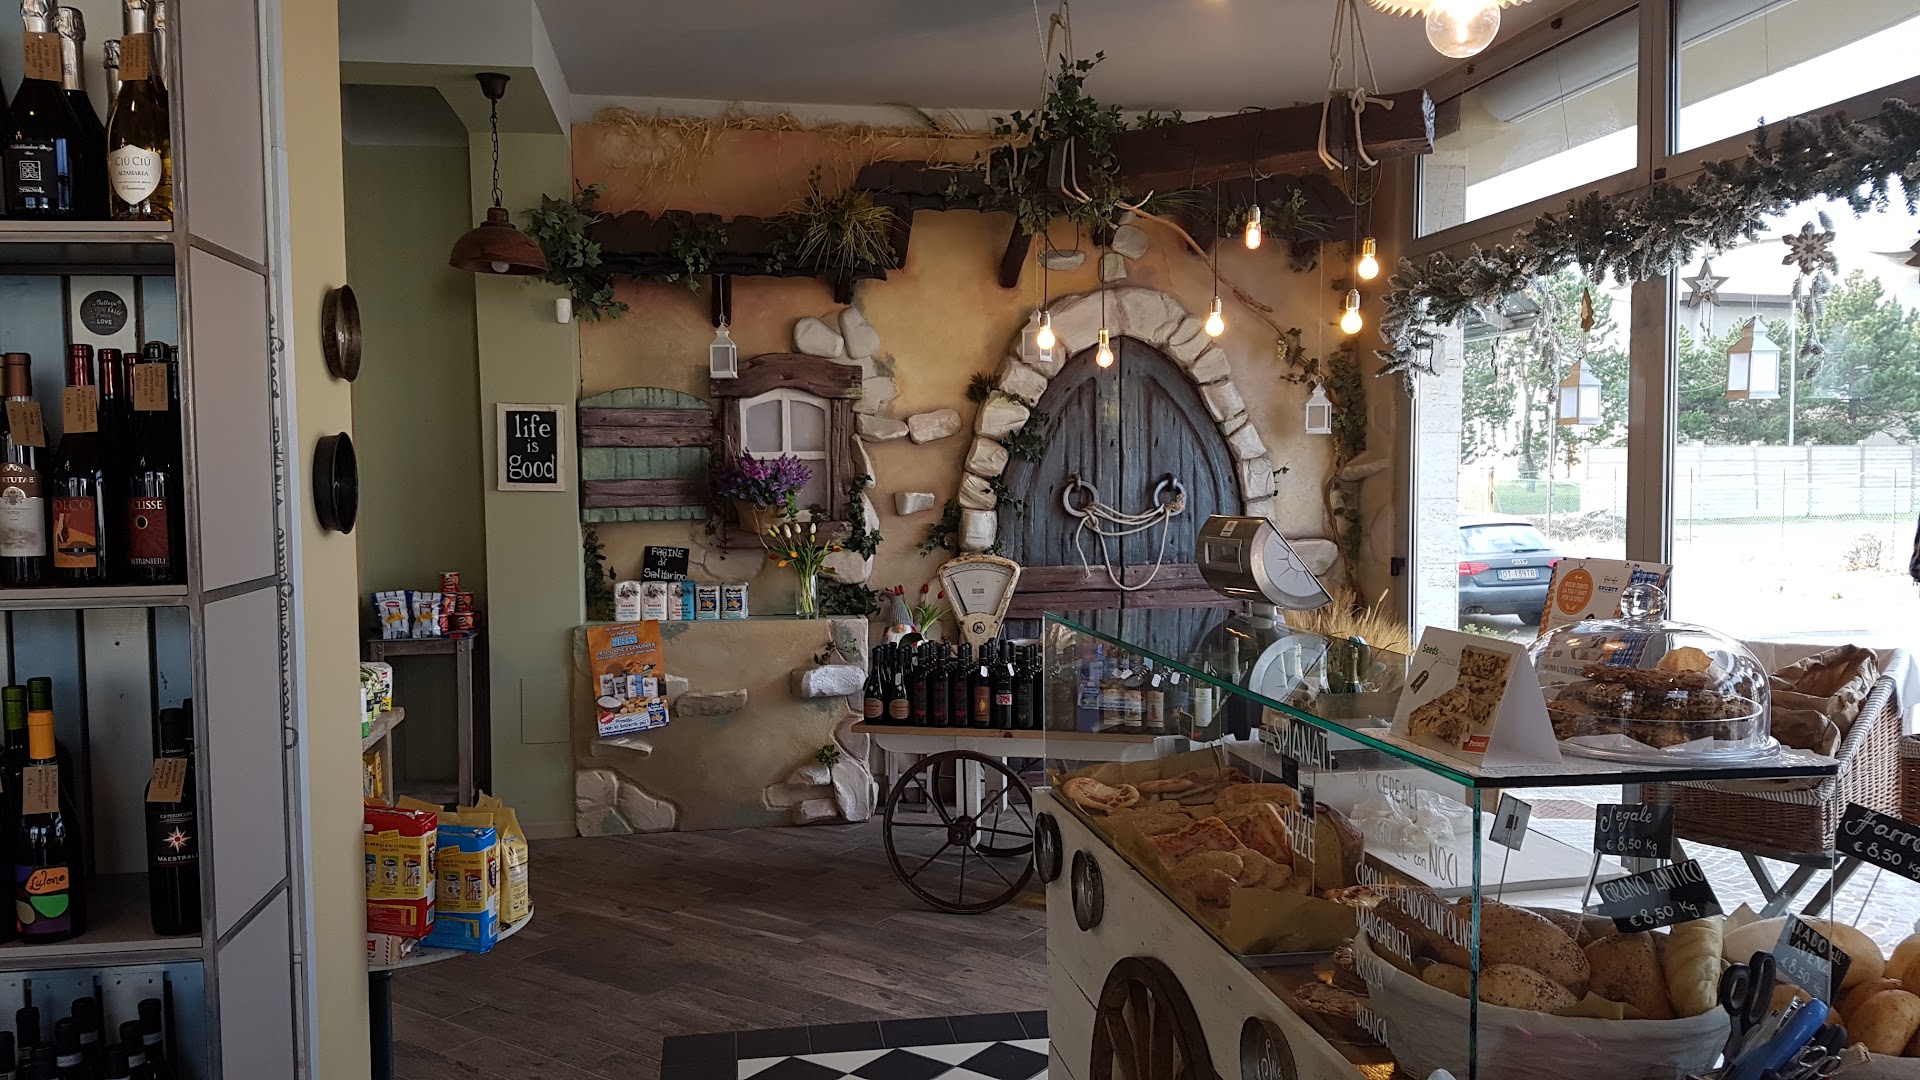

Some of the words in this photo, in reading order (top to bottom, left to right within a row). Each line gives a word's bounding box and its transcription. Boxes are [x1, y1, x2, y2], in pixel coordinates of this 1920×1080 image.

[116, 156, 130, 166] CIÙ
[132, 156, 151, 166] CIÙ
[515, 414, 551, 438] life
[526, 439, 540, 453] is
[509, 454, 556, 479] good
[52, 500, 92, 511] OLCO
[652, 547, 684, 558] FARINE
[658, 556, 668, 567] di
[1422, 643, 1439, 656] Seeds
[1601, 805, 1653, 833] Segale
[1284, 804, 1315, 864] PIZZE
[1606, 841, 1614, 850] €
[1617, 836, 1641, 852] 8,50
[1646, 839, 1658, 857] Kg
[1853, 841, 1864, 853] €
[1429, 842, 1458, 888] NOCI
[1355, 861, 1391, 902] CIPOLLA
[1602, 876, 1650, 903] GRANO
[1651, 862, 1704, 893] ANTICO
[1680, 901, 1699, 918] Kg
[1356, 902, 1412, 966] MARGHERITA
[1787, 917, 1827, 954] ARABO
[1356, 948, 1384, 993] ROSSA
[1356, 1001, 1389, 1049] BIANCA
